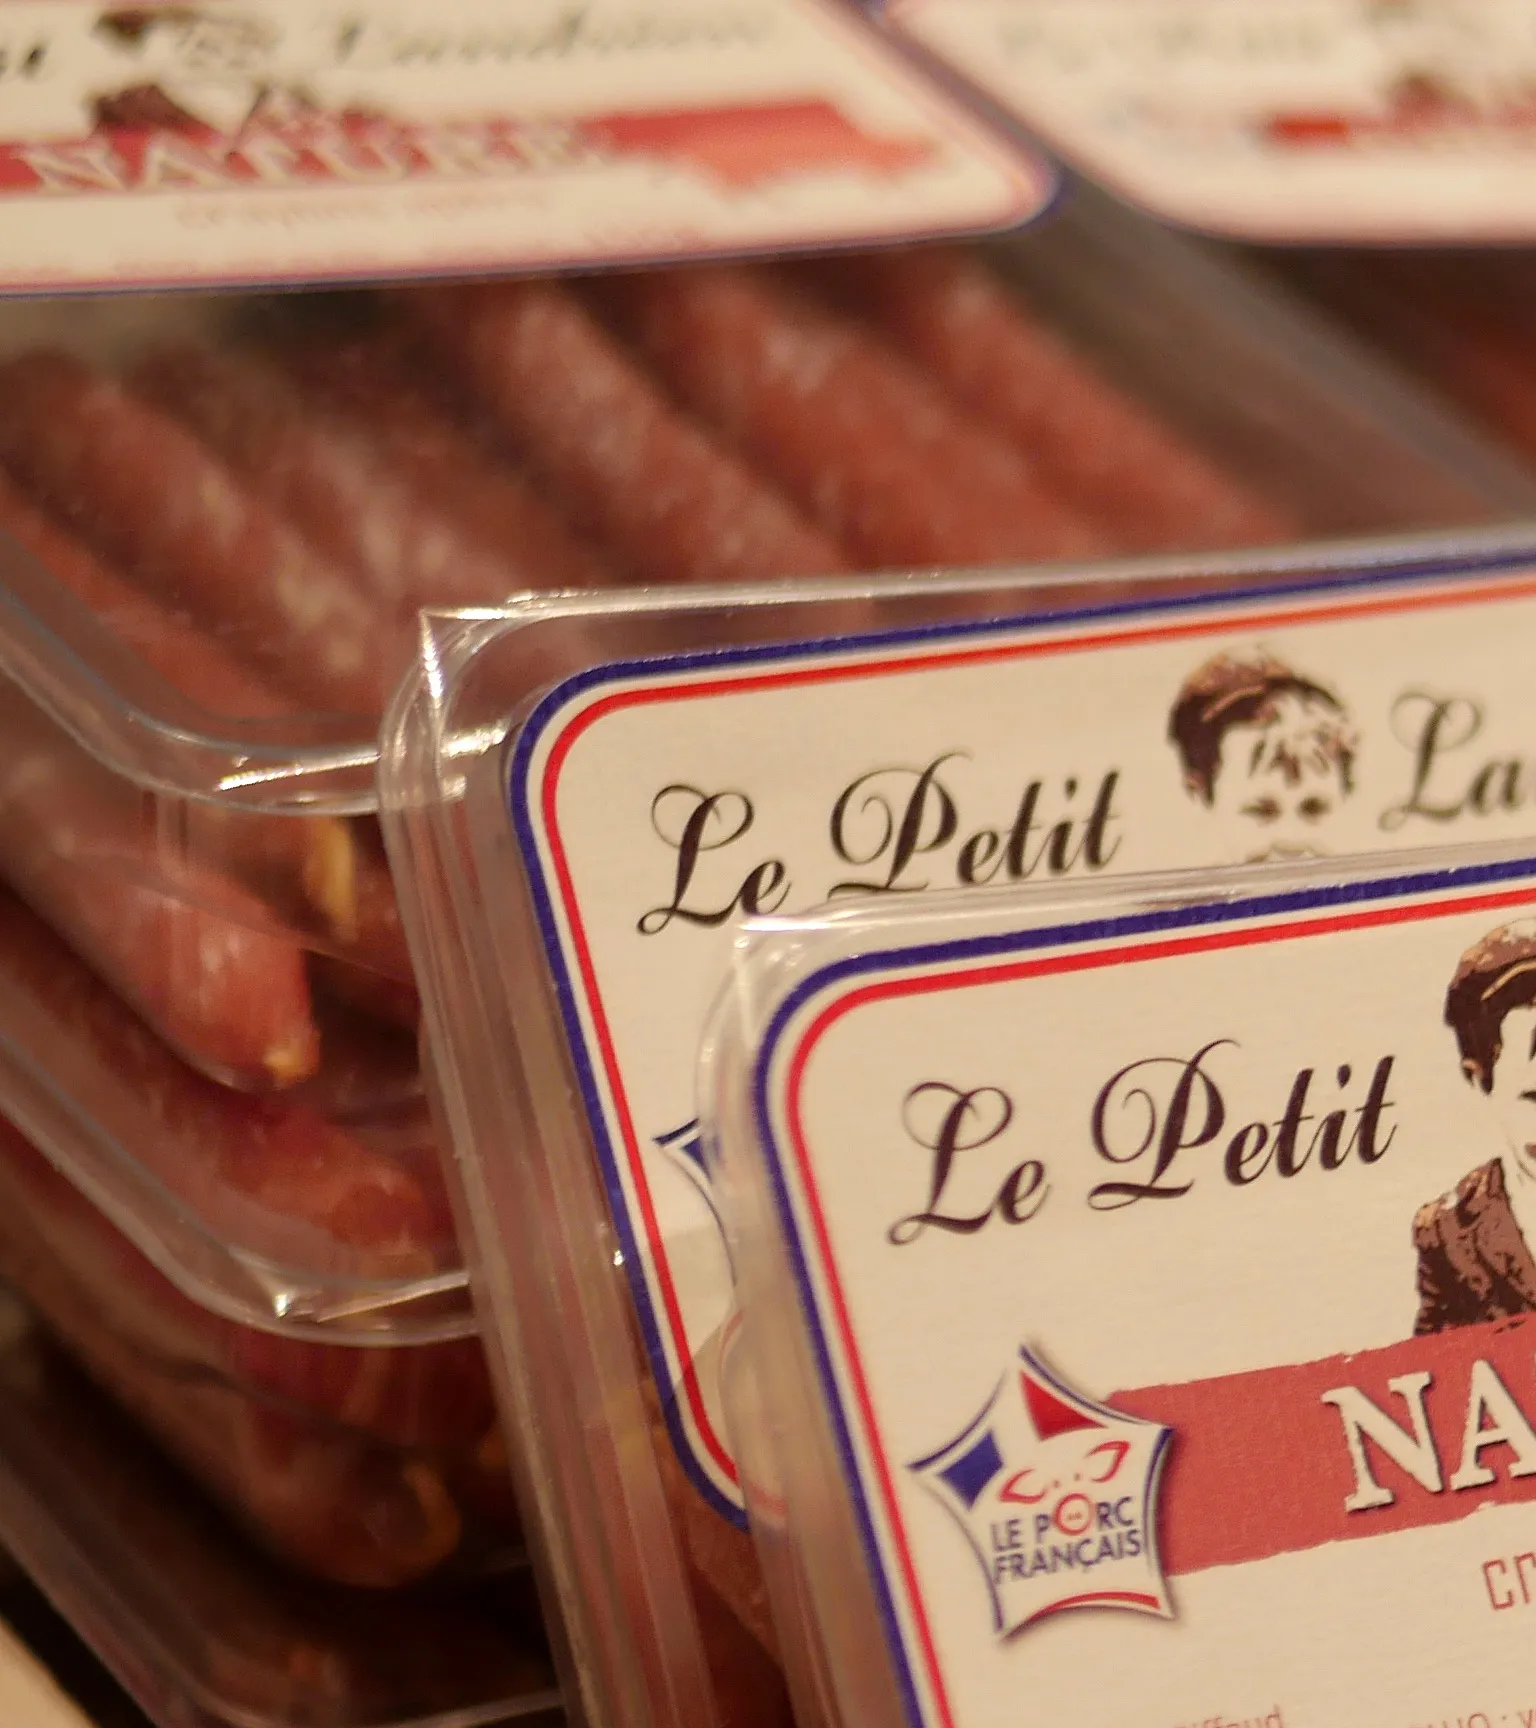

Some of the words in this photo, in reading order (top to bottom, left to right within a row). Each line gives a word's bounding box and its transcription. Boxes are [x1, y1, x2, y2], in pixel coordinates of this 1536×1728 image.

[637, 783, 792, 935] Le
[828, 748, 1122, 900] Petit
[887, 1081, 1052, 1246] Le
[1087, 1038, 1398, 1211] Petit
[990, 1518, 1024, 1553] LE
[1034, 1492, 1135, 1537] PORC
[993, 1528, 1142, 1586] FRANÇAIS
